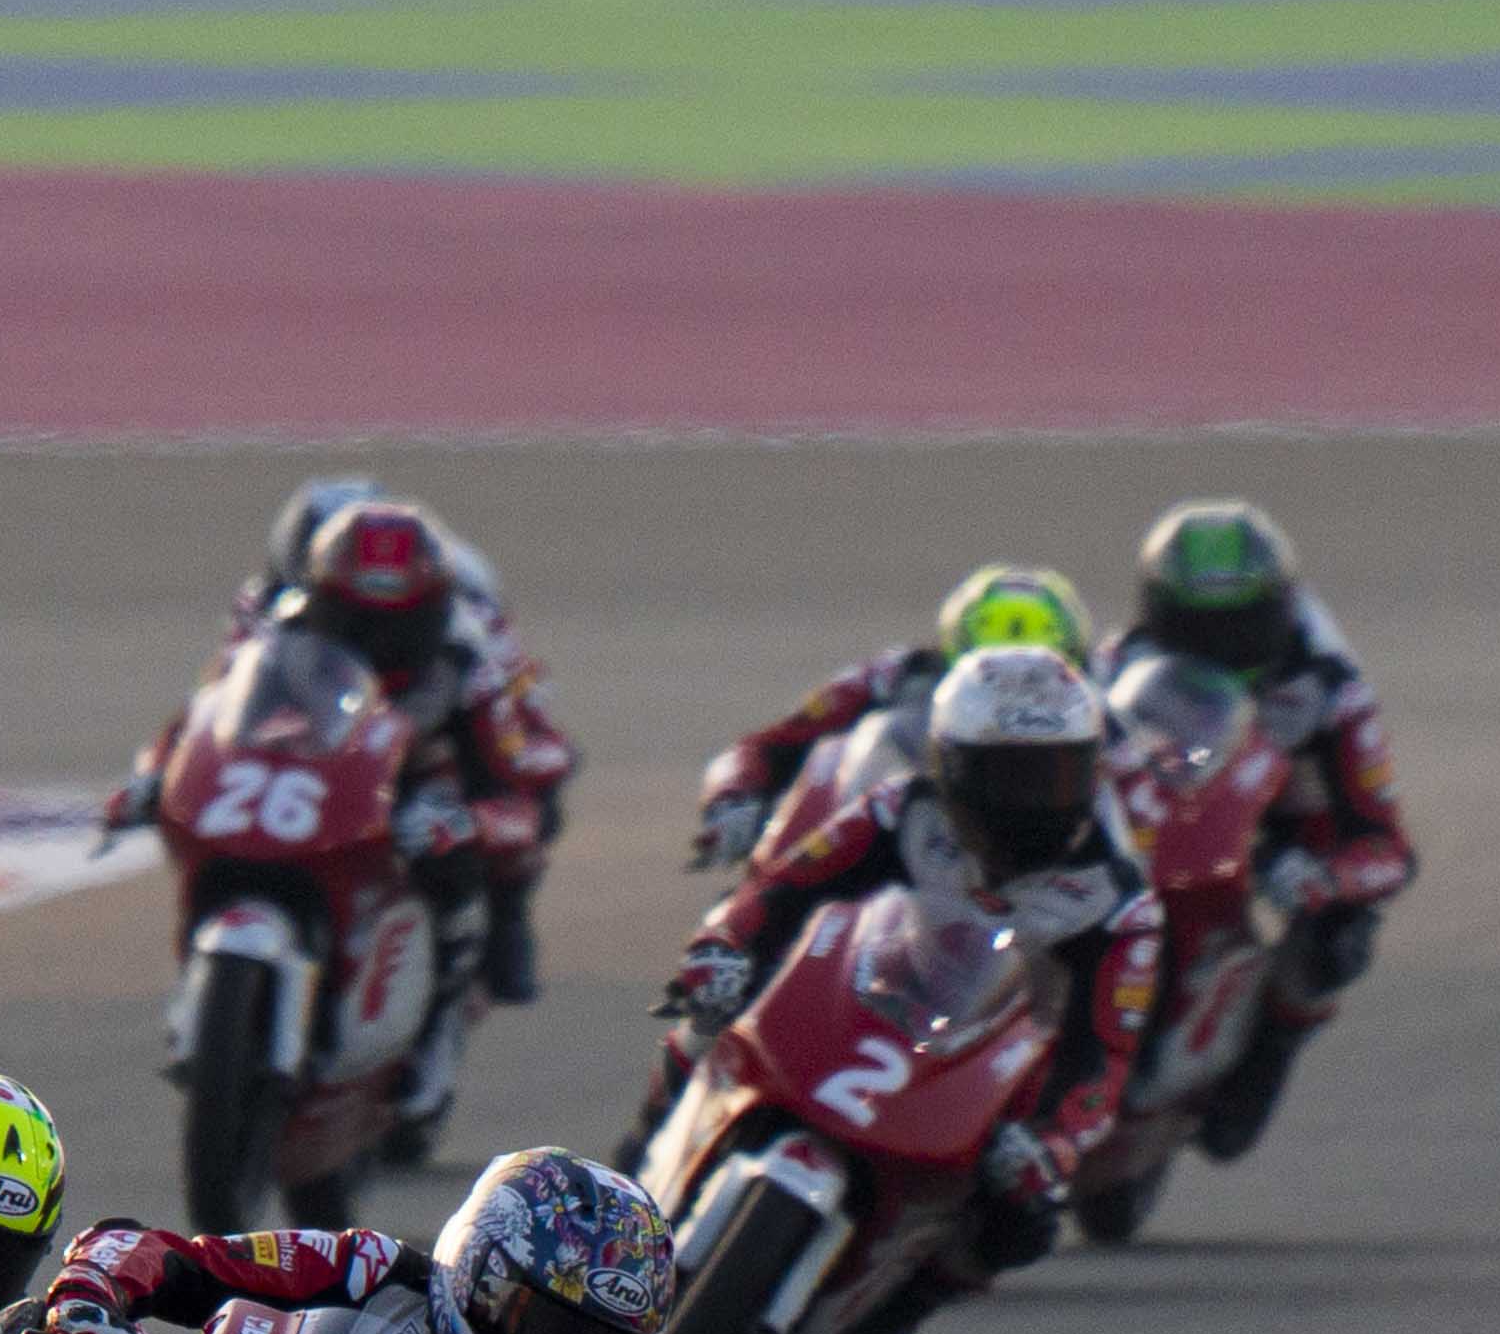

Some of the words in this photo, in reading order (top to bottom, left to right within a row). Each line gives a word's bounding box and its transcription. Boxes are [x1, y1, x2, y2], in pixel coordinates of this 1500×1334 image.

[196, 760, 329, 842] 26
[812, 1037, 911, 1127] 2
[589, 1271, 649, 1307] Arai
